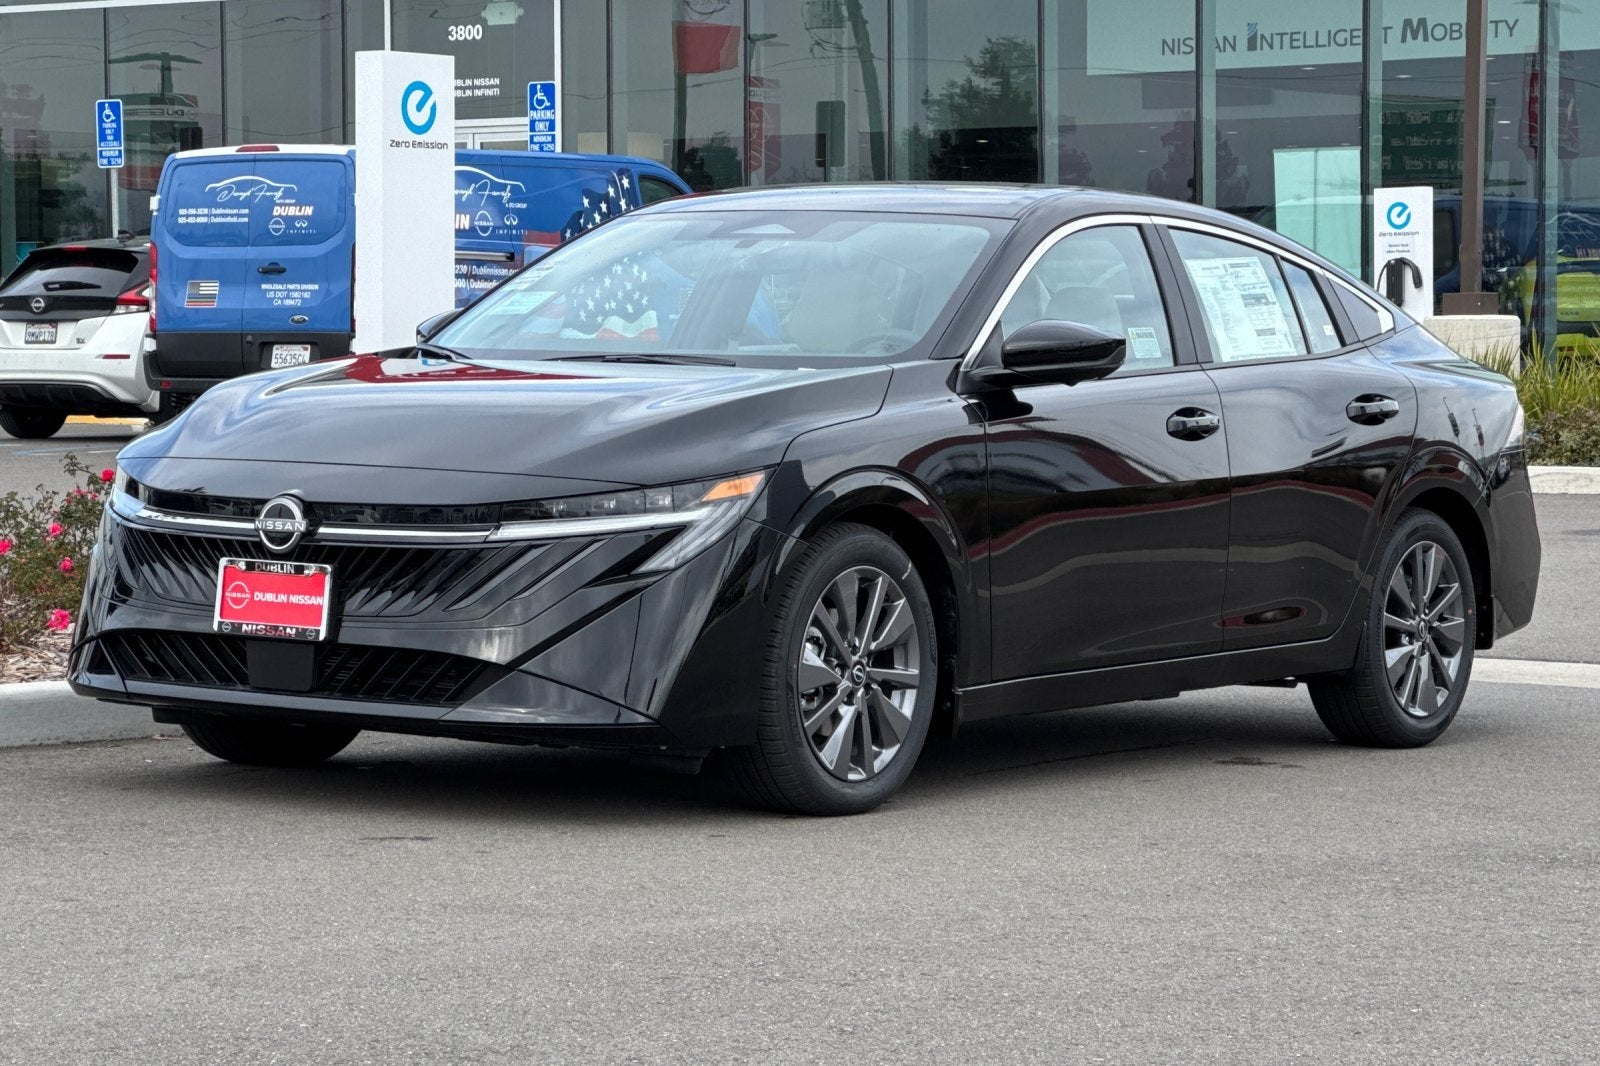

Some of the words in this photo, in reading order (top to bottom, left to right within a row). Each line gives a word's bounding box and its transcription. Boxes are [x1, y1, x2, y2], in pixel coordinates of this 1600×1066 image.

[448, 24, 482, 41] 3800
[1161, 35, 1237, 56] NISAN
[1247, 22, 1393, 52] INTELLIGET
[1400, 17, 1519, 44] MOBTY
[454, 79, 472, 87] BLIN
[473, 77, 500, 86] NISSAN
[454, 89, 472, 97] BLIN
[474, 88, 500, 97] INFINITI
[530, 110, 555, 120] PARKING
[535, 120, 550, 131] ONLY
[389, 139, 410, 148] Zero
[412, 140, 449, 150] Emission
[272, 206, 313, 216] DUBLIN
[273, 298, 281, 306] CA
[255, 519, 305, 532] NISSAN
[254, 562, 295, 574] DUBLIN
[225, 591, 251, 599] NISSAN
[253, 591, 288, 603] DUBLIN
[288, 593, 324, 606] NISSAN
[241, 623, 296, 638] NISSAN
